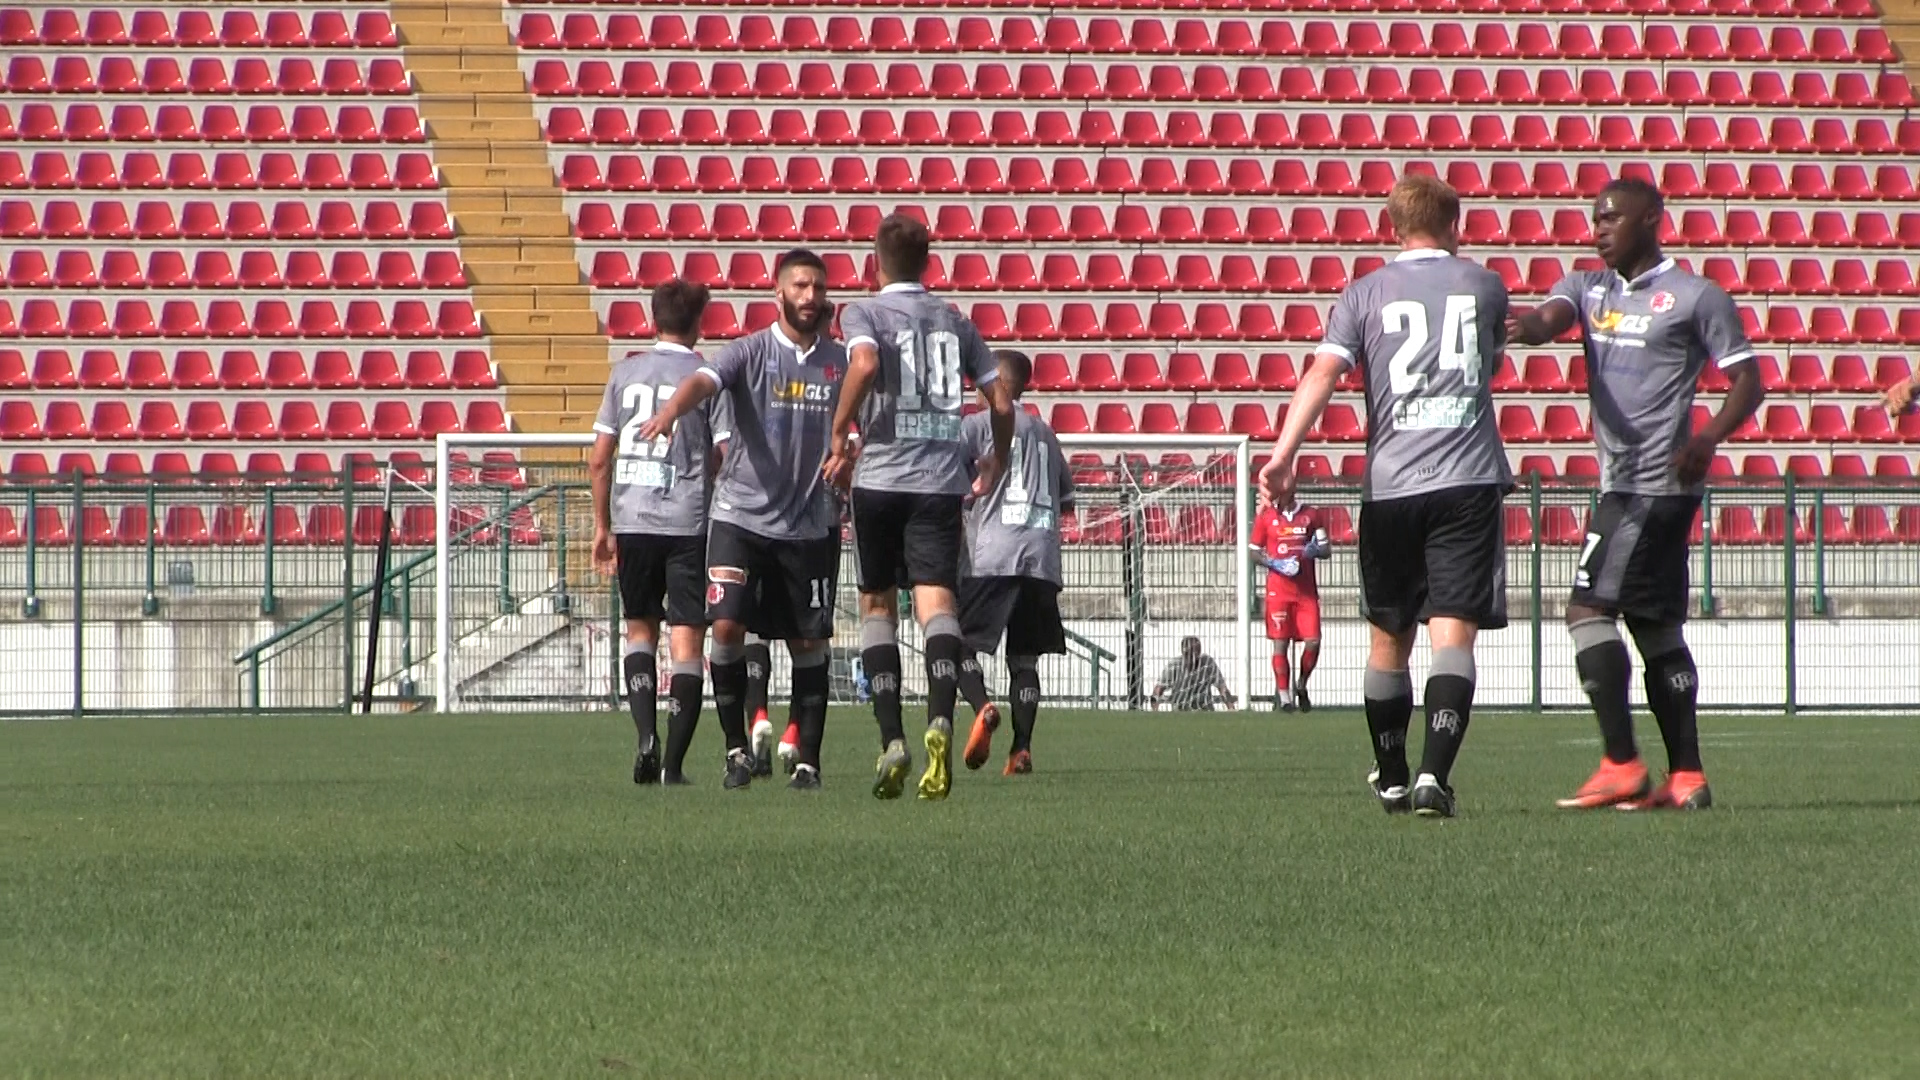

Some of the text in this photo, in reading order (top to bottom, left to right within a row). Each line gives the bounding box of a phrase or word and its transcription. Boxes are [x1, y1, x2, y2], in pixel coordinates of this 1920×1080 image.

[1382, 295, 1482, 394] 24
[806, 383, 832, 400] GLS
[1005, 436, 1052, 507] 11
[1578, 533, 1602, 567] 7
